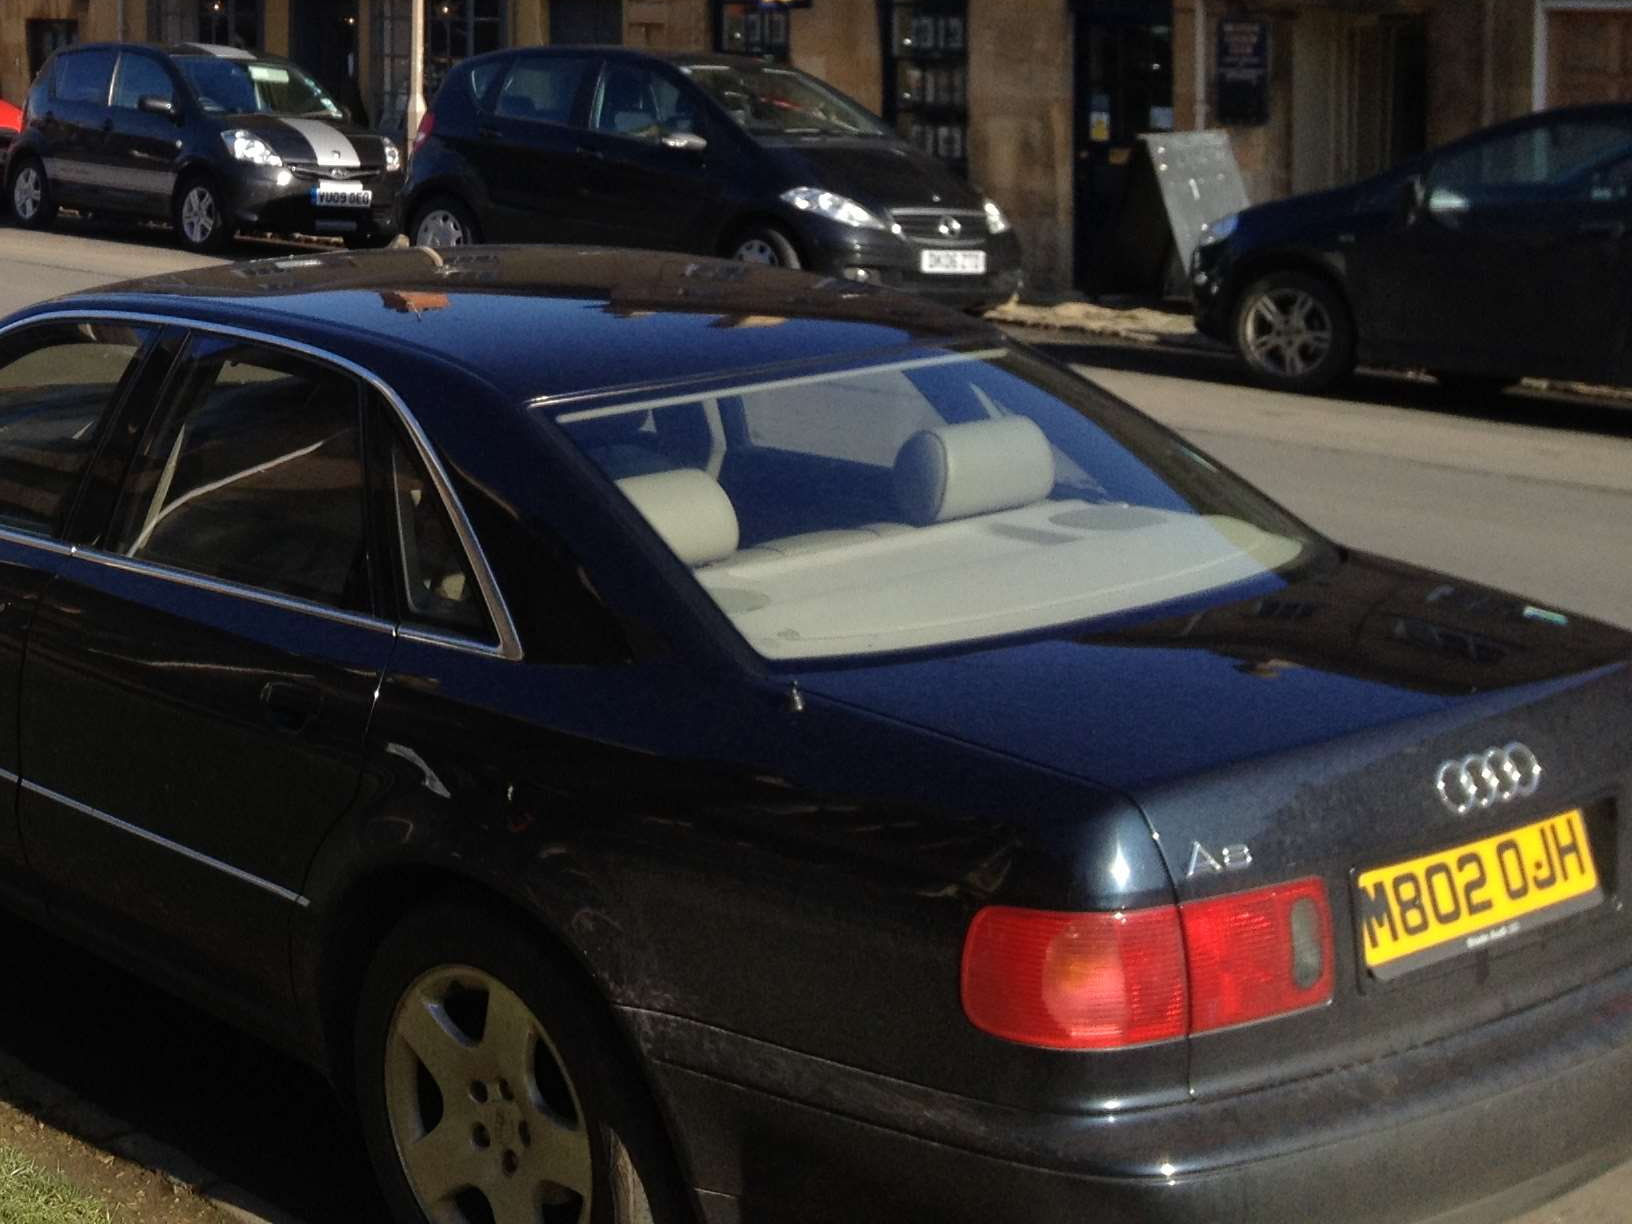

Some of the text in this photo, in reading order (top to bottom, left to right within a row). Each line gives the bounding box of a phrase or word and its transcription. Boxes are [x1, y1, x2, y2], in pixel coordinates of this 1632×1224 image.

[1186, 840, 1253, 876] A8
[1361, 817, 1587, 949] M802 OJH
